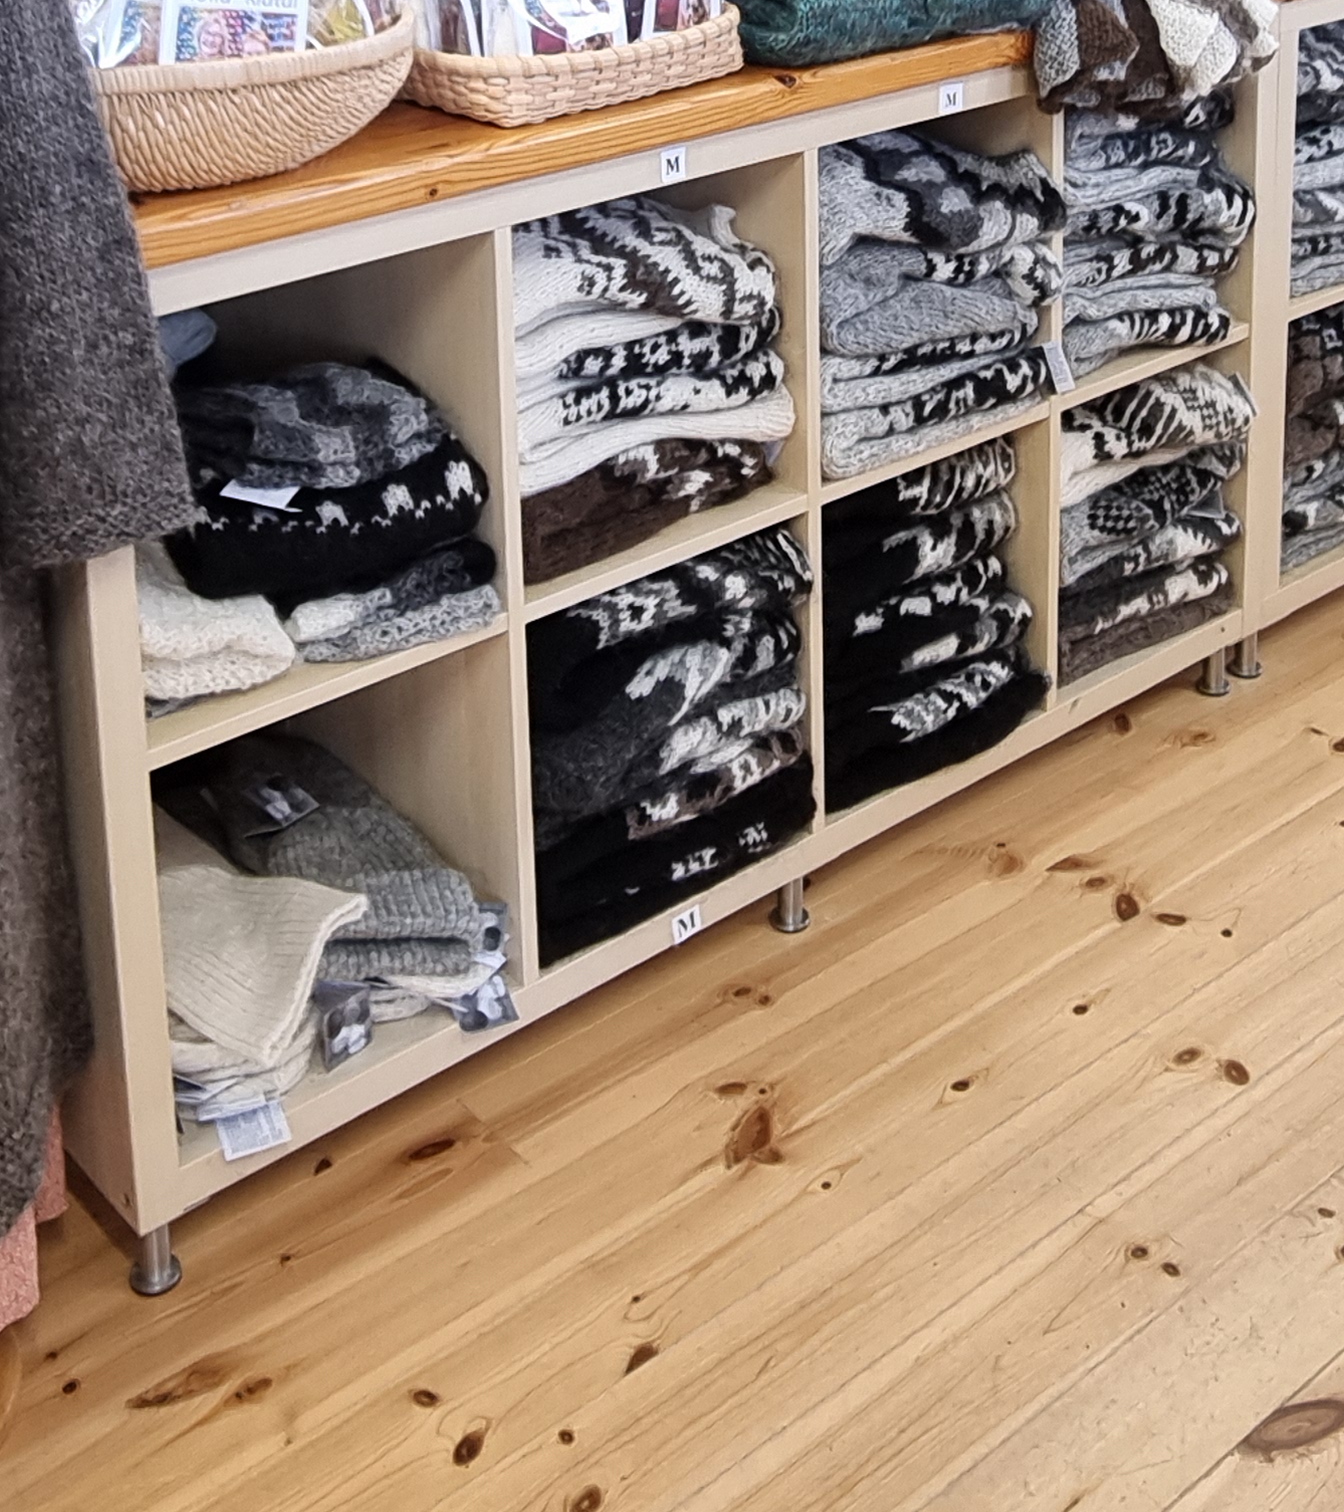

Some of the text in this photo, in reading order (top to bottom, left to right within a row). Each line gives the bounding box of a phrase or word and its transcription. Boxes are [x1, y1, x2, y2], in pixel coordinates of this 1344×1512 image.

[945, 91, 957, 107] M
[666, 155, 680, 175] M
[677, 909, 696, 938] M
